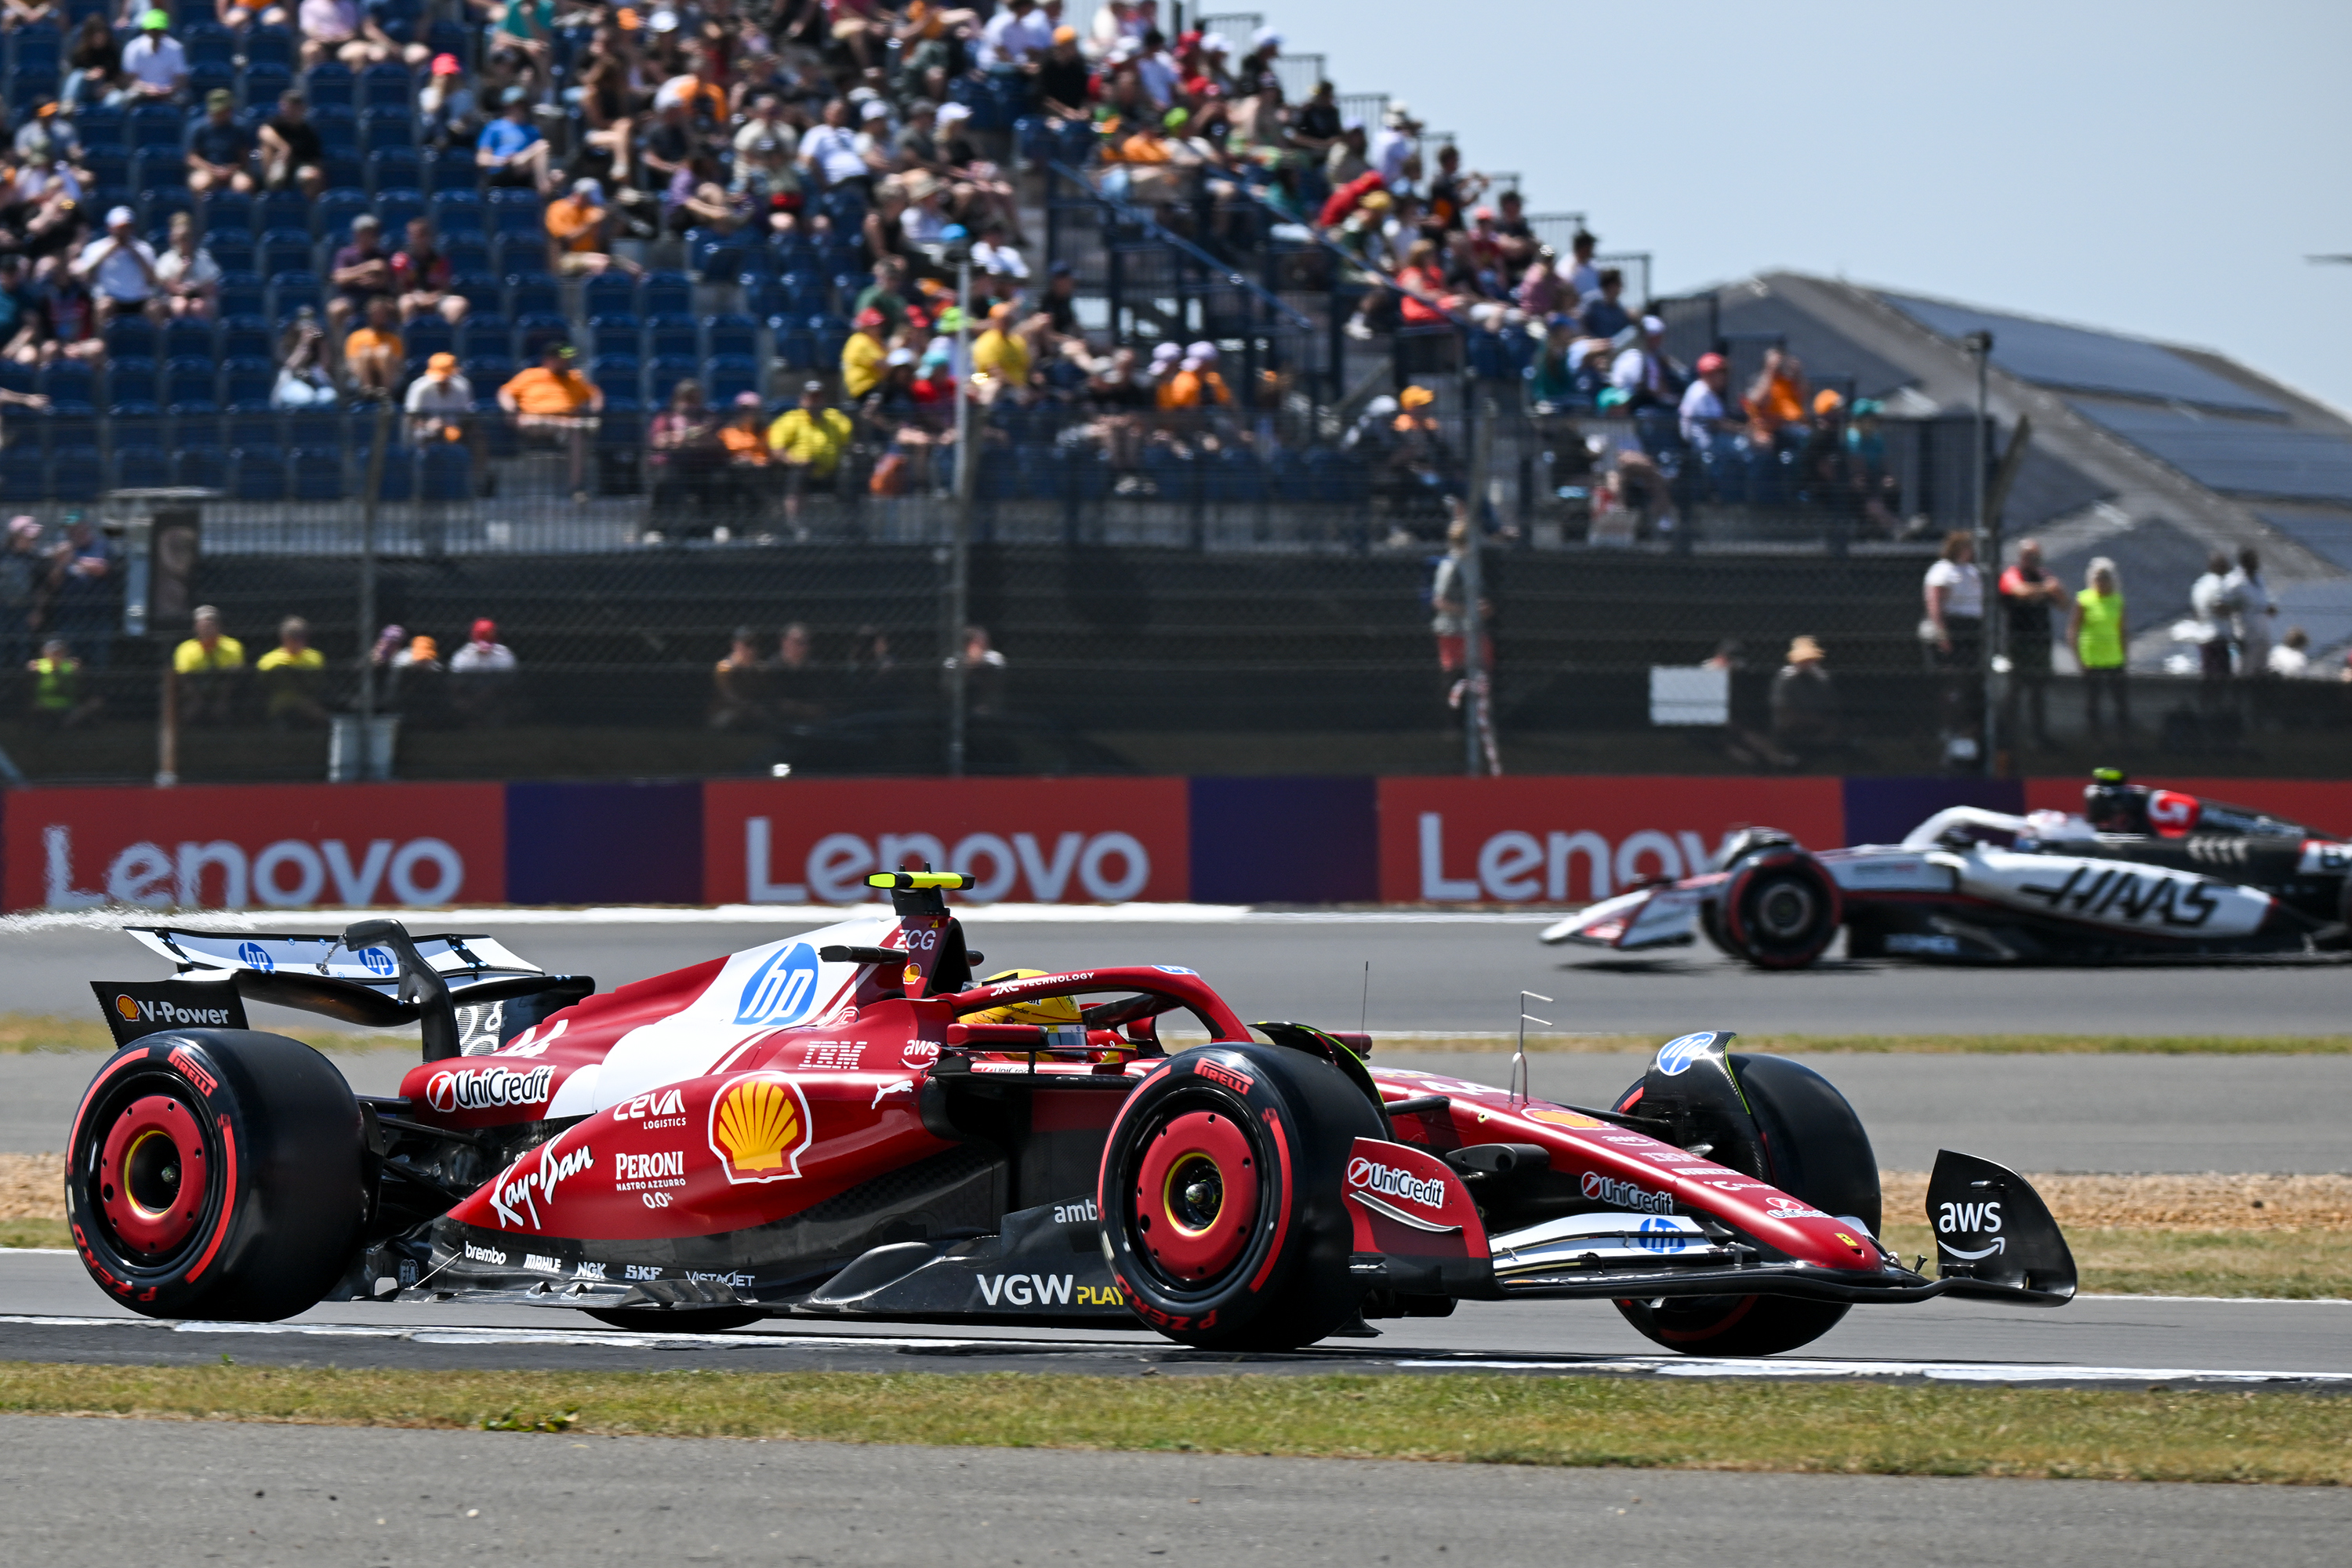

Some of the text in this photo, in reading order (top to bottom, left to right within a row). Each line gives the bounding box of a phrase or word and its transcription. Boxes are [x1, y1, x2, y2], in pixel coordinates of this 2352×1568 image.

[42, 824, 465, 908] Lenovo
[745, 816, 1151, 903] Lenovo
[1417, 811, 1725, 902] Lenov
[2018, 866, 2220, 927] HAAS
[893, 929, 936, 950] ZCG
[243, 942, 270, 971] hp
[364, 948, 390, 975] hp
[737, 942, 815, 1025] hp
[1023, 972, 1094, 987] TECHNOLOGY
[137, 1000, 229, 1025] V-Power
[797, 1040, 868, 1070] IBM
[903, 1039, 942, 1056] aws
[167, 1046, 219, 1098] PIRELLI
[454, 1066, 551, 1107] UniCredit
[1193, 1057, 1254, 1095] PIRELLI
[643, 1117, 686, 1130] LOGISTICS
[615, 1151, 684, 1180] PERONI
[616, 1178, 686, 1191] NASTRO AZZURRO
[1371, 1164, 1443, 1206] UniCredit
[1601, 1177, 1673, 1214] UniCredit
[642, 1191, 673, 1209] 0.0%
[1939, 1201, 2002, 1233] aws
[1646, 1218, 1682, 1254] hp
[464, 1240, 507, 1265] brembo
[522, 1254, 561, 1273] MAHLE
[574, 1261, 607, 1279] NGK
[624, 1264, 662, 1280] SKF
[976, 1274, 1073, 1305] VGW
